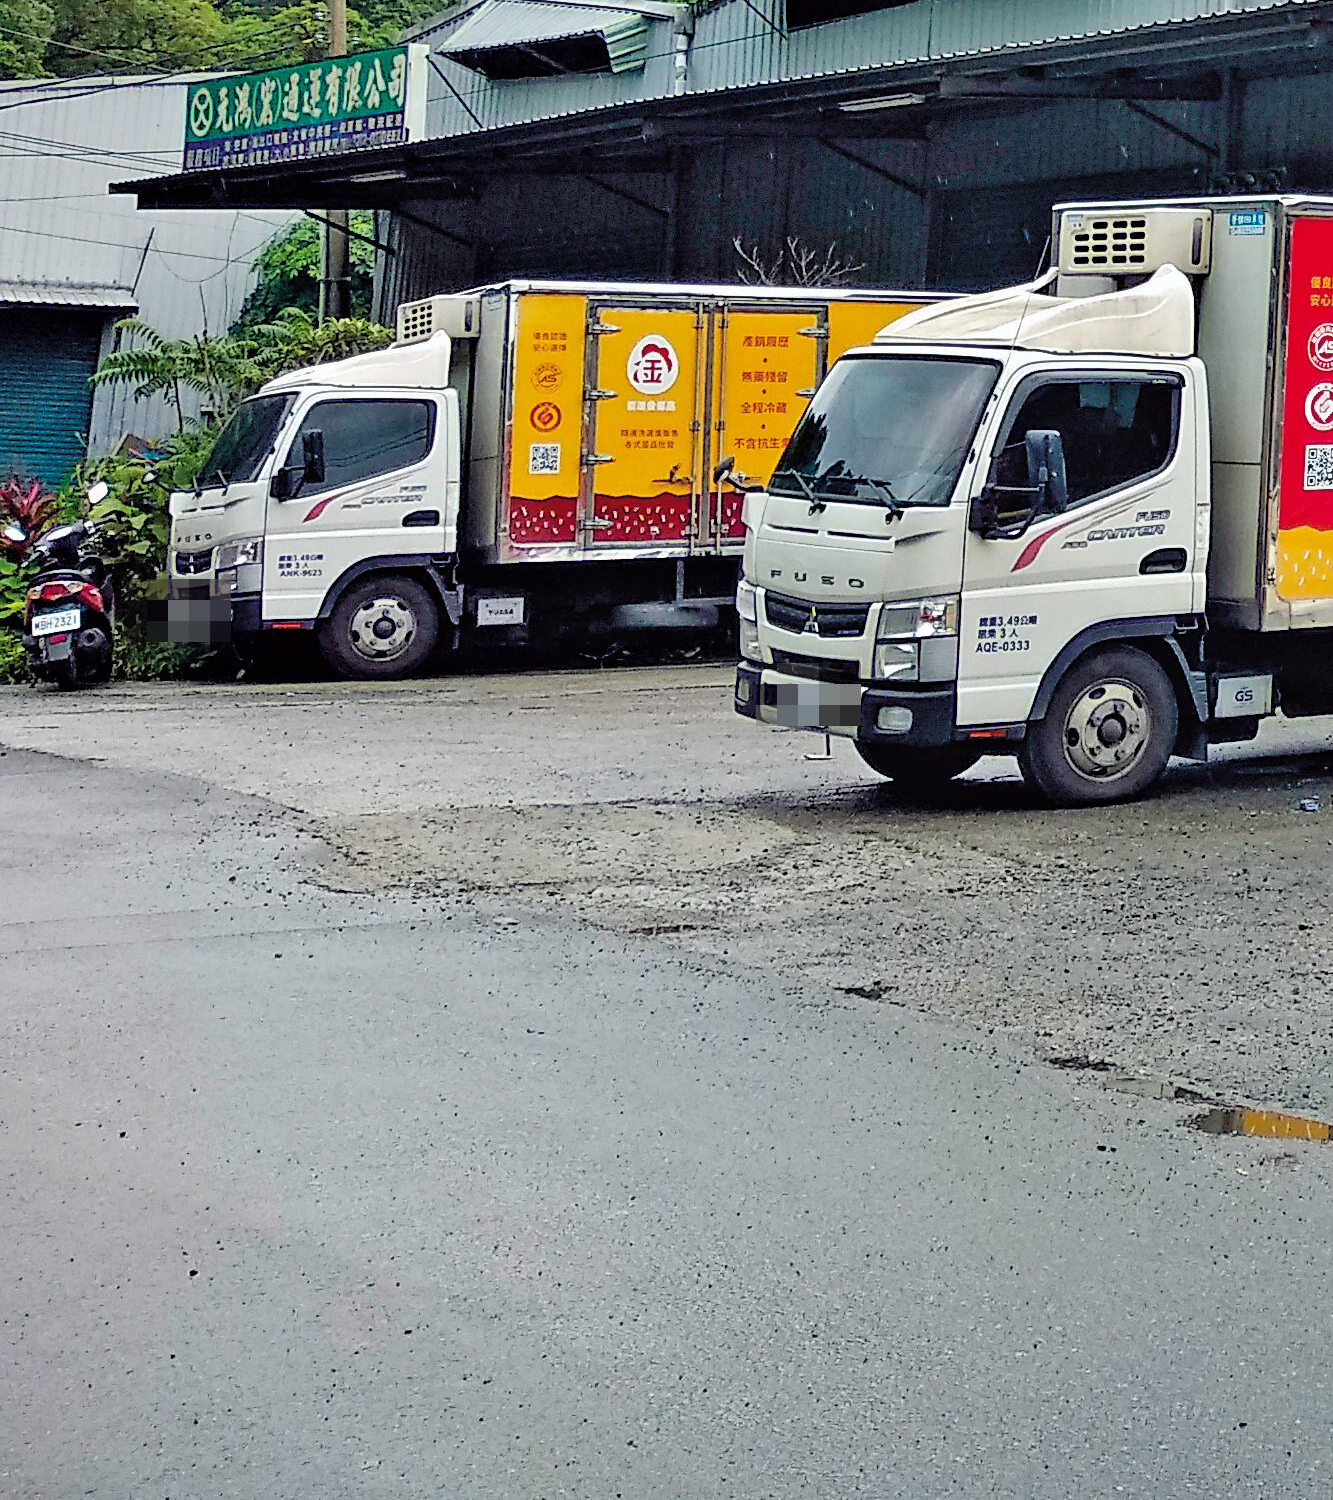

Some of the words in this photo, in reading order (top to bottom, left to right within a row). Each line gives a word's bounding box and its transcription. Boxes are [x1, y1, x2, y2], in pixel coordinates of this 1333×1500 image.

[1135, 509, 1171, 523] FUSO
[1086, 524, 1166, 542] CANTER
[770, 569, 865, 589] FUSO
[1000, 627, 1007, 639] 3
[1009, 627, 1019, 638] 人
[975, 640, 1030, 653] AQE-0333
[1235, 689, 1254, 702] GS
